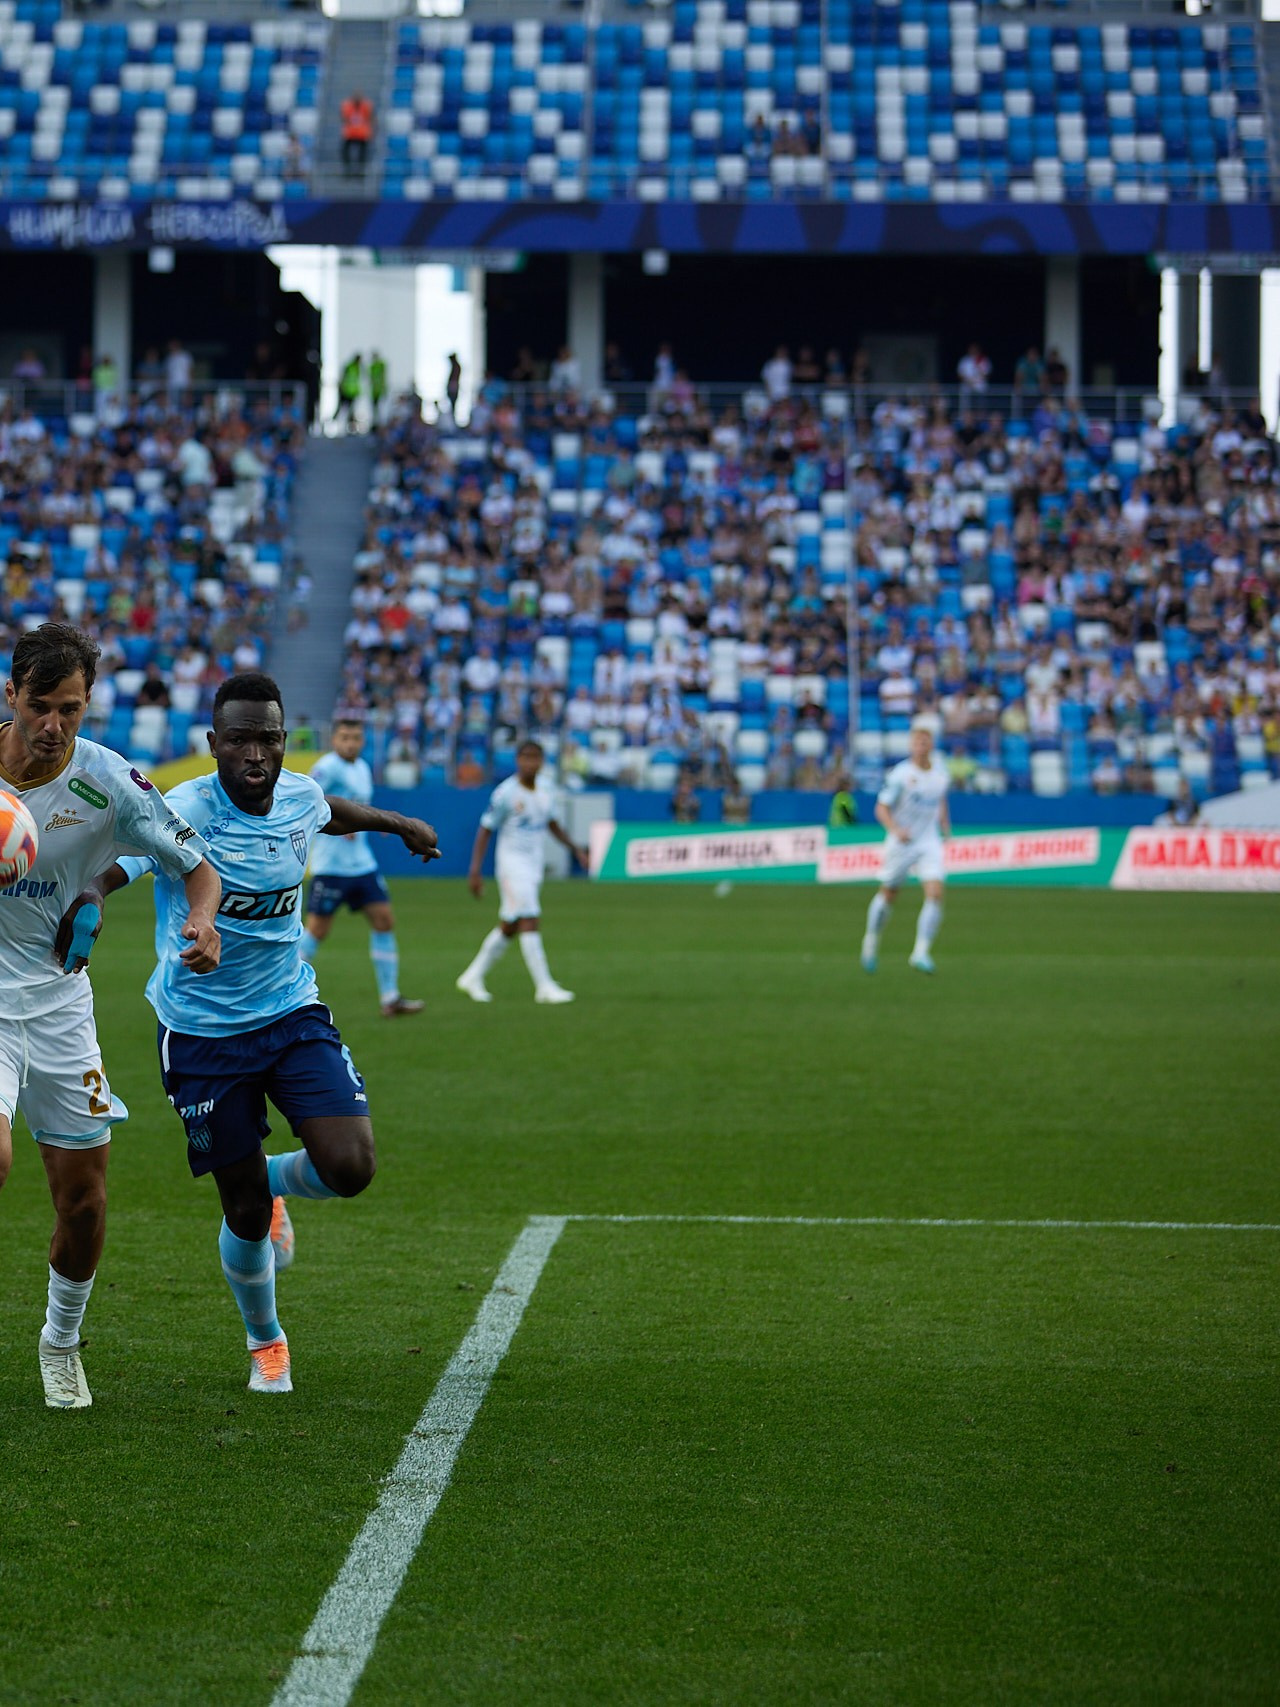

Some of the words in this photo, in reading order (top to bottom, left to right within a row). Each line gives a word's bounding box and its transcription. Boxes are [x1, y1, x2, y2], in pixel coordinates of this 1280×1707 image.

[221, 852, 246, 861] JAKO
[1132, 834, 1211, 870] ПАПА
[220, 886, 299, 917] PAR
